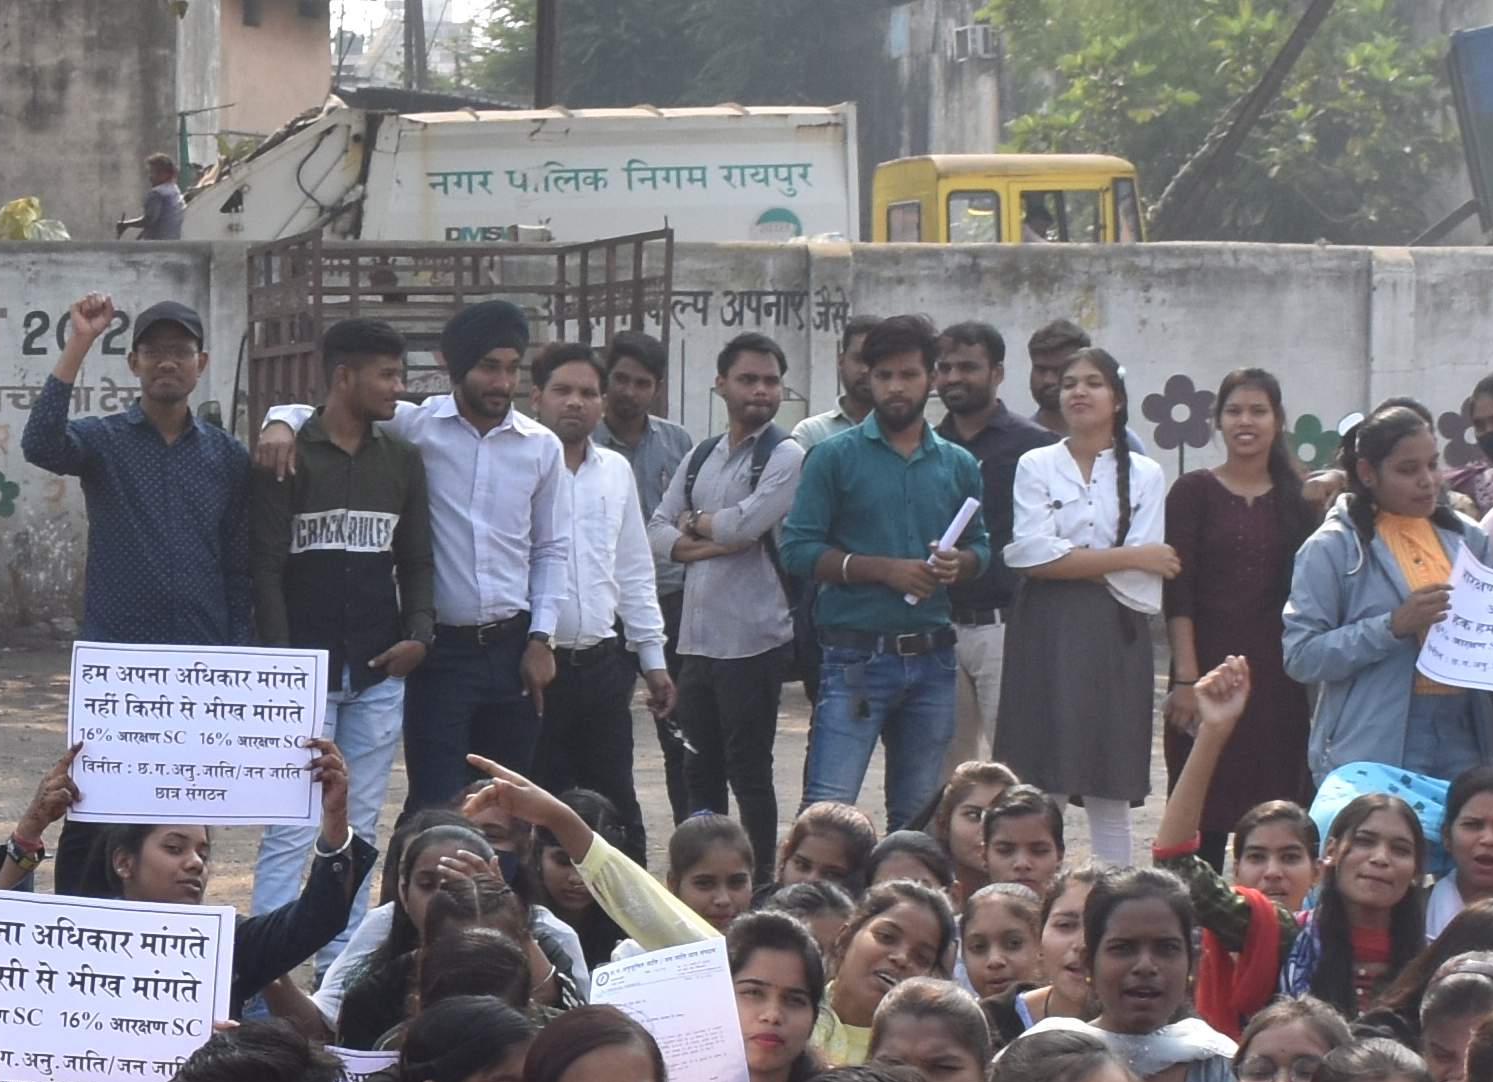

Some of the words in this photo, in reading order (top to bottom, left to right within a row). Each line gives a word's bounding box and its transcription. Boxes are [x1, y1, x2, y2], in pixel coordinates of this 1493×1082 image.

[427, 170, 493, 195] नगर
[622, 159, 707, 190] निगम
[719, 162, 813, 197] रायपुर
[82, 663, 110, 683] हम
[116, 665, 170, 685] अपना
[176, 661, 252, 690] अधिकार
[257, 665, 309, 690] मांगते
[84, 693, 119, 718] नहीं
[125, 693, 174, 719] किसी
[179, 696, 196, 720] से
[204, 696, 246, 721] भीख
[252, 700, 305, 724] मांगते
[32, 916, 134, 959] अधिकार
[140, 925, 210, 960] मांगते
[36, 962, 58, 993] से
[67, 963, 125, 999] भीख
[132, 969, 202, 1003] मांगते
